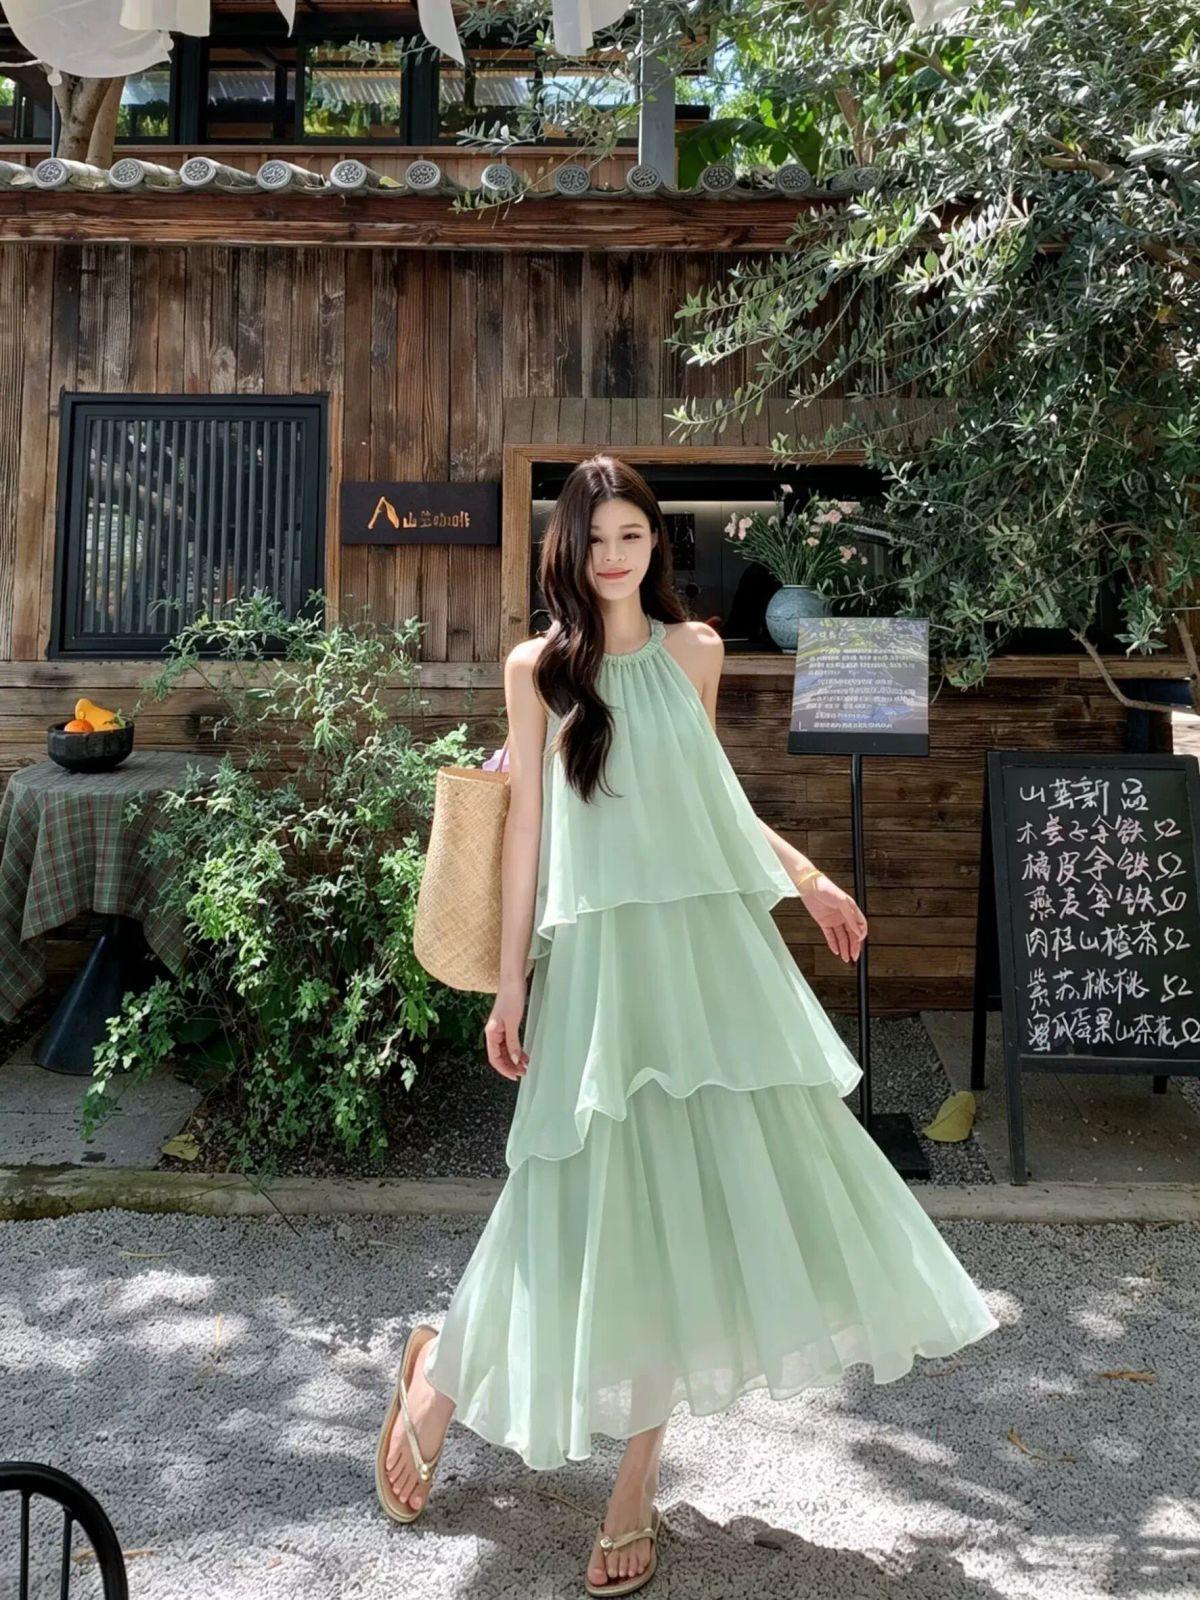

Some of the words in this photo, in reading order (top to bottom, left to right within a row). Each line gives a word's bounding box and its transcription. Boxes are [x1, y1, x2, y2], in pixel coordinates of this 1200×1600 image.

[1017, 814, 1147, 846] 木姜子拿铁
[1154, 818, 1181, 841] 52
[1021, 845, 1152, 886] 橘皮拿铁
[1155, 851, 1187, 881] 52
[1024, 882, 1157, 921] 燕麦拿铁
[1156, 886, 1187, 917] 50
[1025, 920, 1158, 962] 肉桂山楂茶
[1163, 927, 1191, 956] 52
[1026, 967, 1150, 1011] 紫苏桃桃
[1160, 974, 1194, 1003] 52
